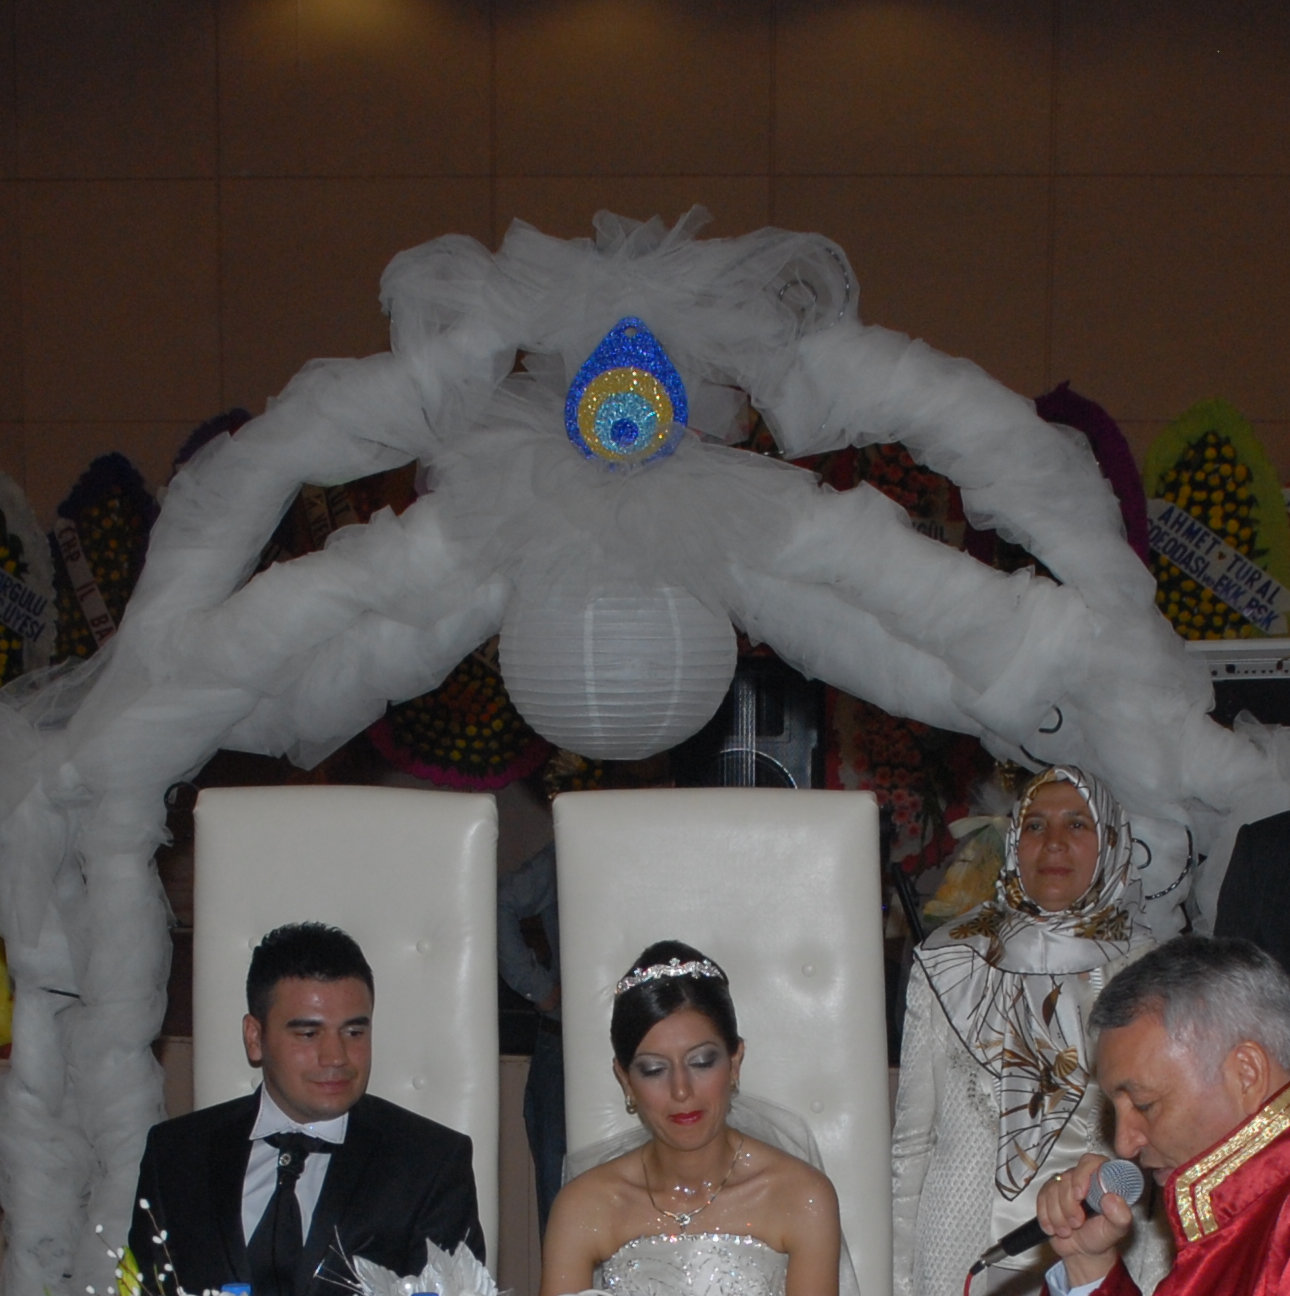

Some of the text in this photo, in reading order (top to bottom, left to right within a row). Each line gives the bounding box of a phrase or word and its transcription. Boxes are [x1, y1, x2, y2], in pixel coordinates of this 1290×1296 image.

[57, 526, 81, 562] CHP
[90, 614, 115, 641] BA
[1158, 505, 1280, 605] AHMET TURAL
